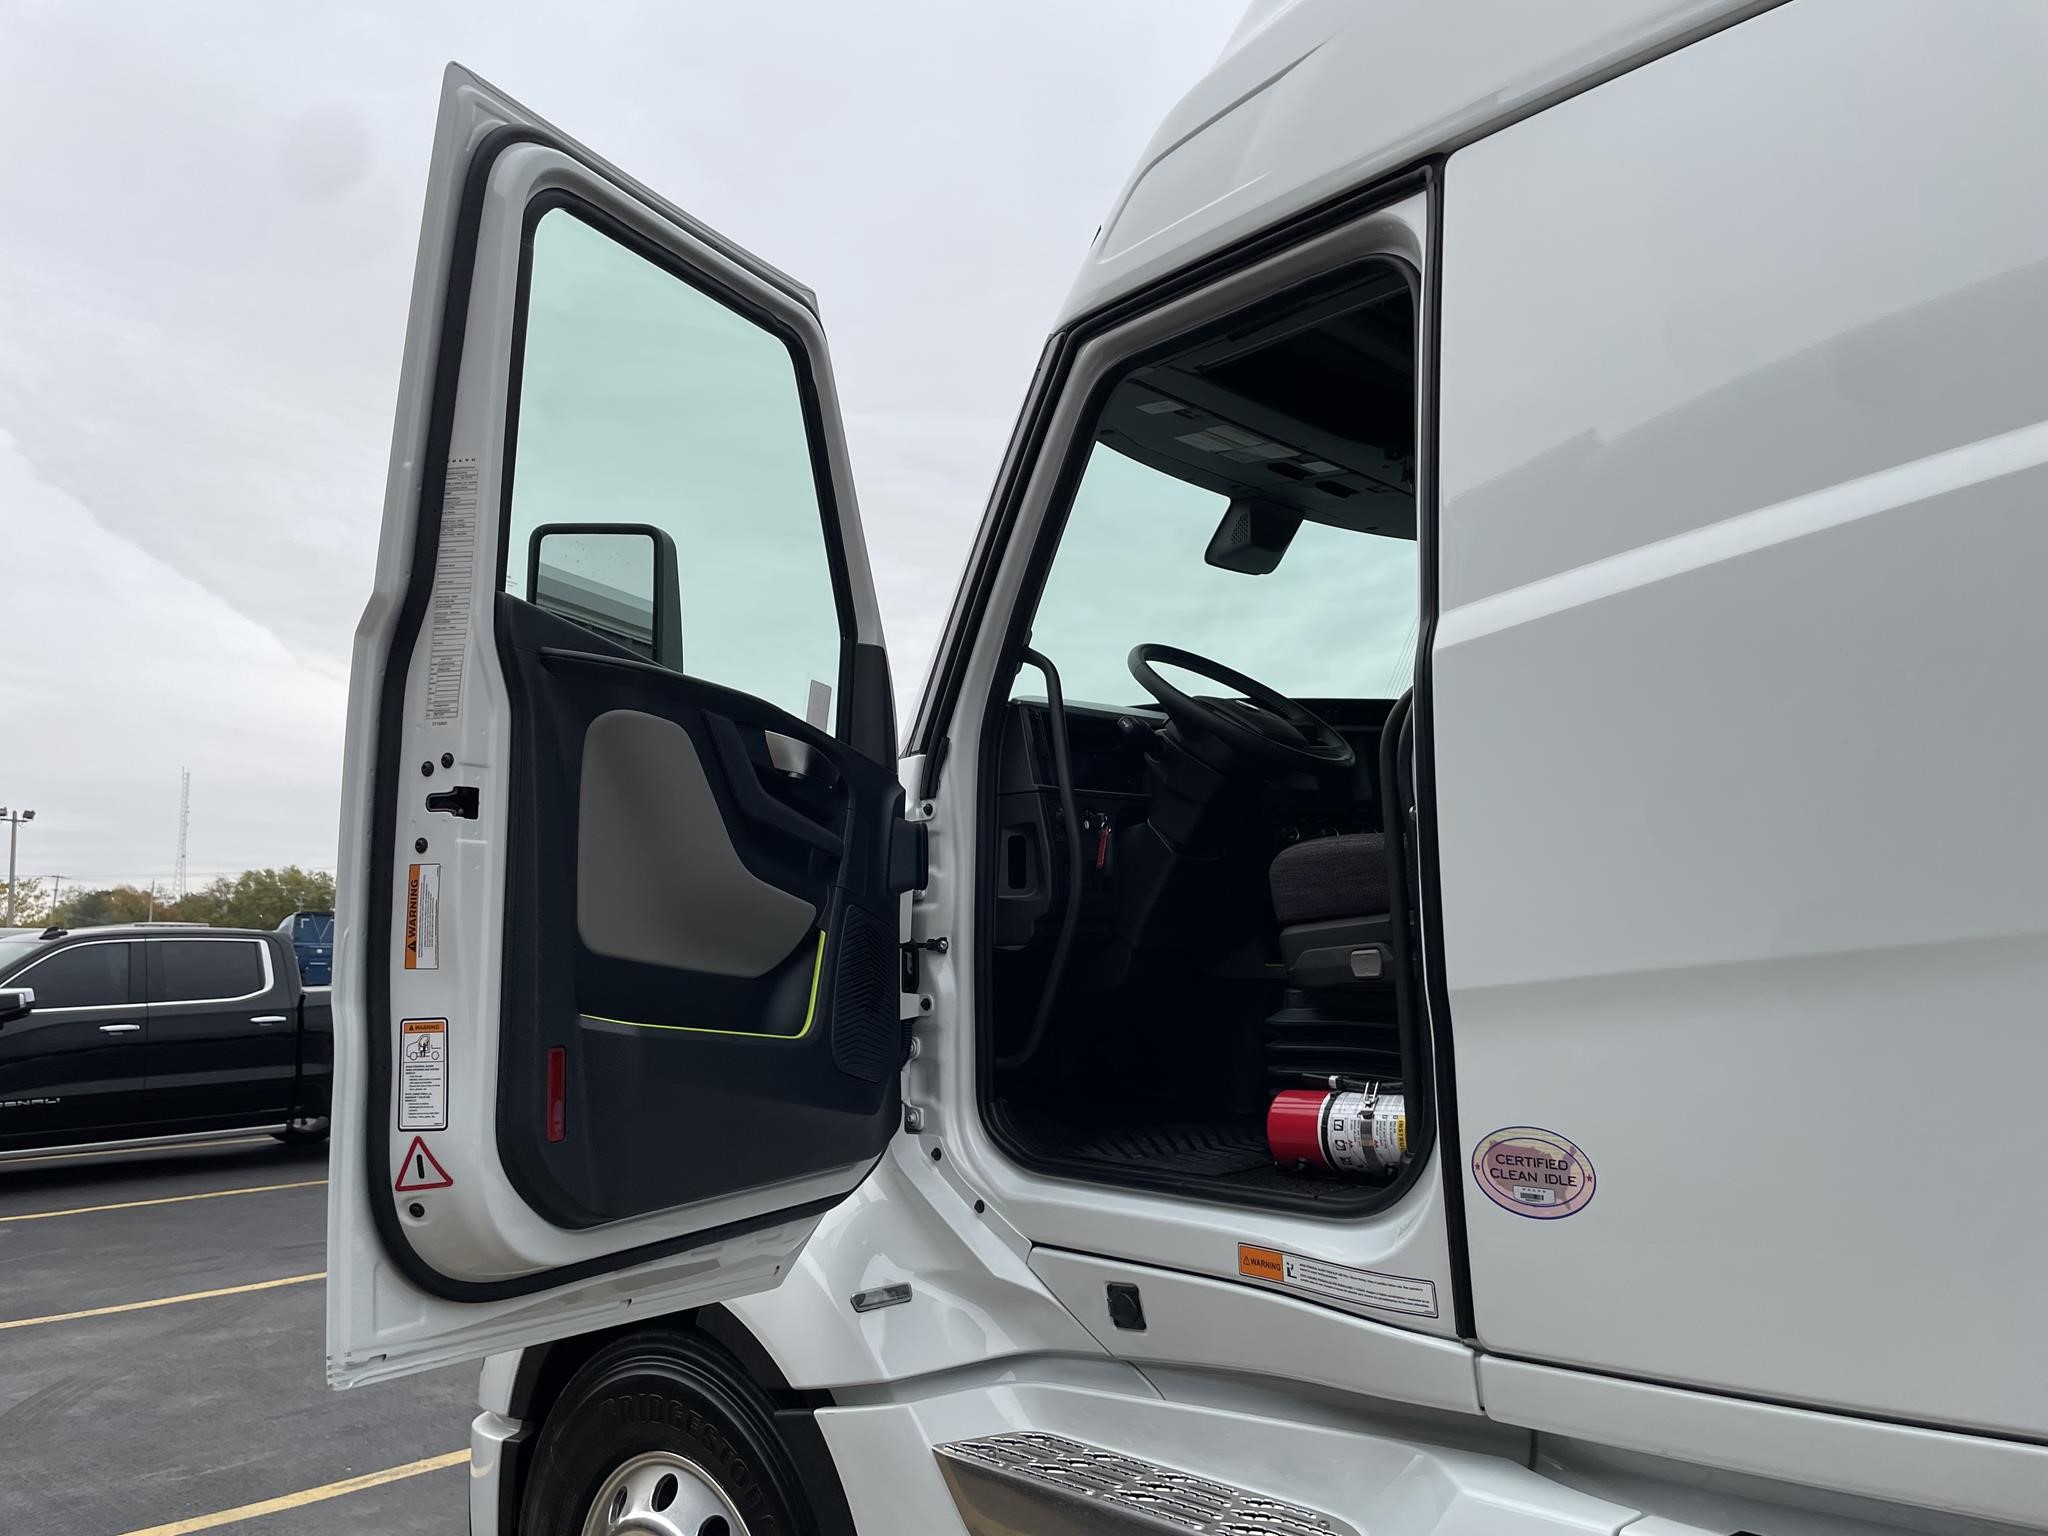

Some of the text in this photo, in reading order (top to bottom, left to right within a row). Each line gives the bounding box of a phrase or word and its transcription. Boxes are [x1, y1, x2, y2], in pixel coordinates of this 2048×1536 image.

[408, 879, 419, 938] WARNING
[1495, 1153, 1568, 1171] CERTIFIED
[1489, 1167, 1577, 1187] CLEAN IDLE
[1250, 1258, 1281, 1272] WARNING
